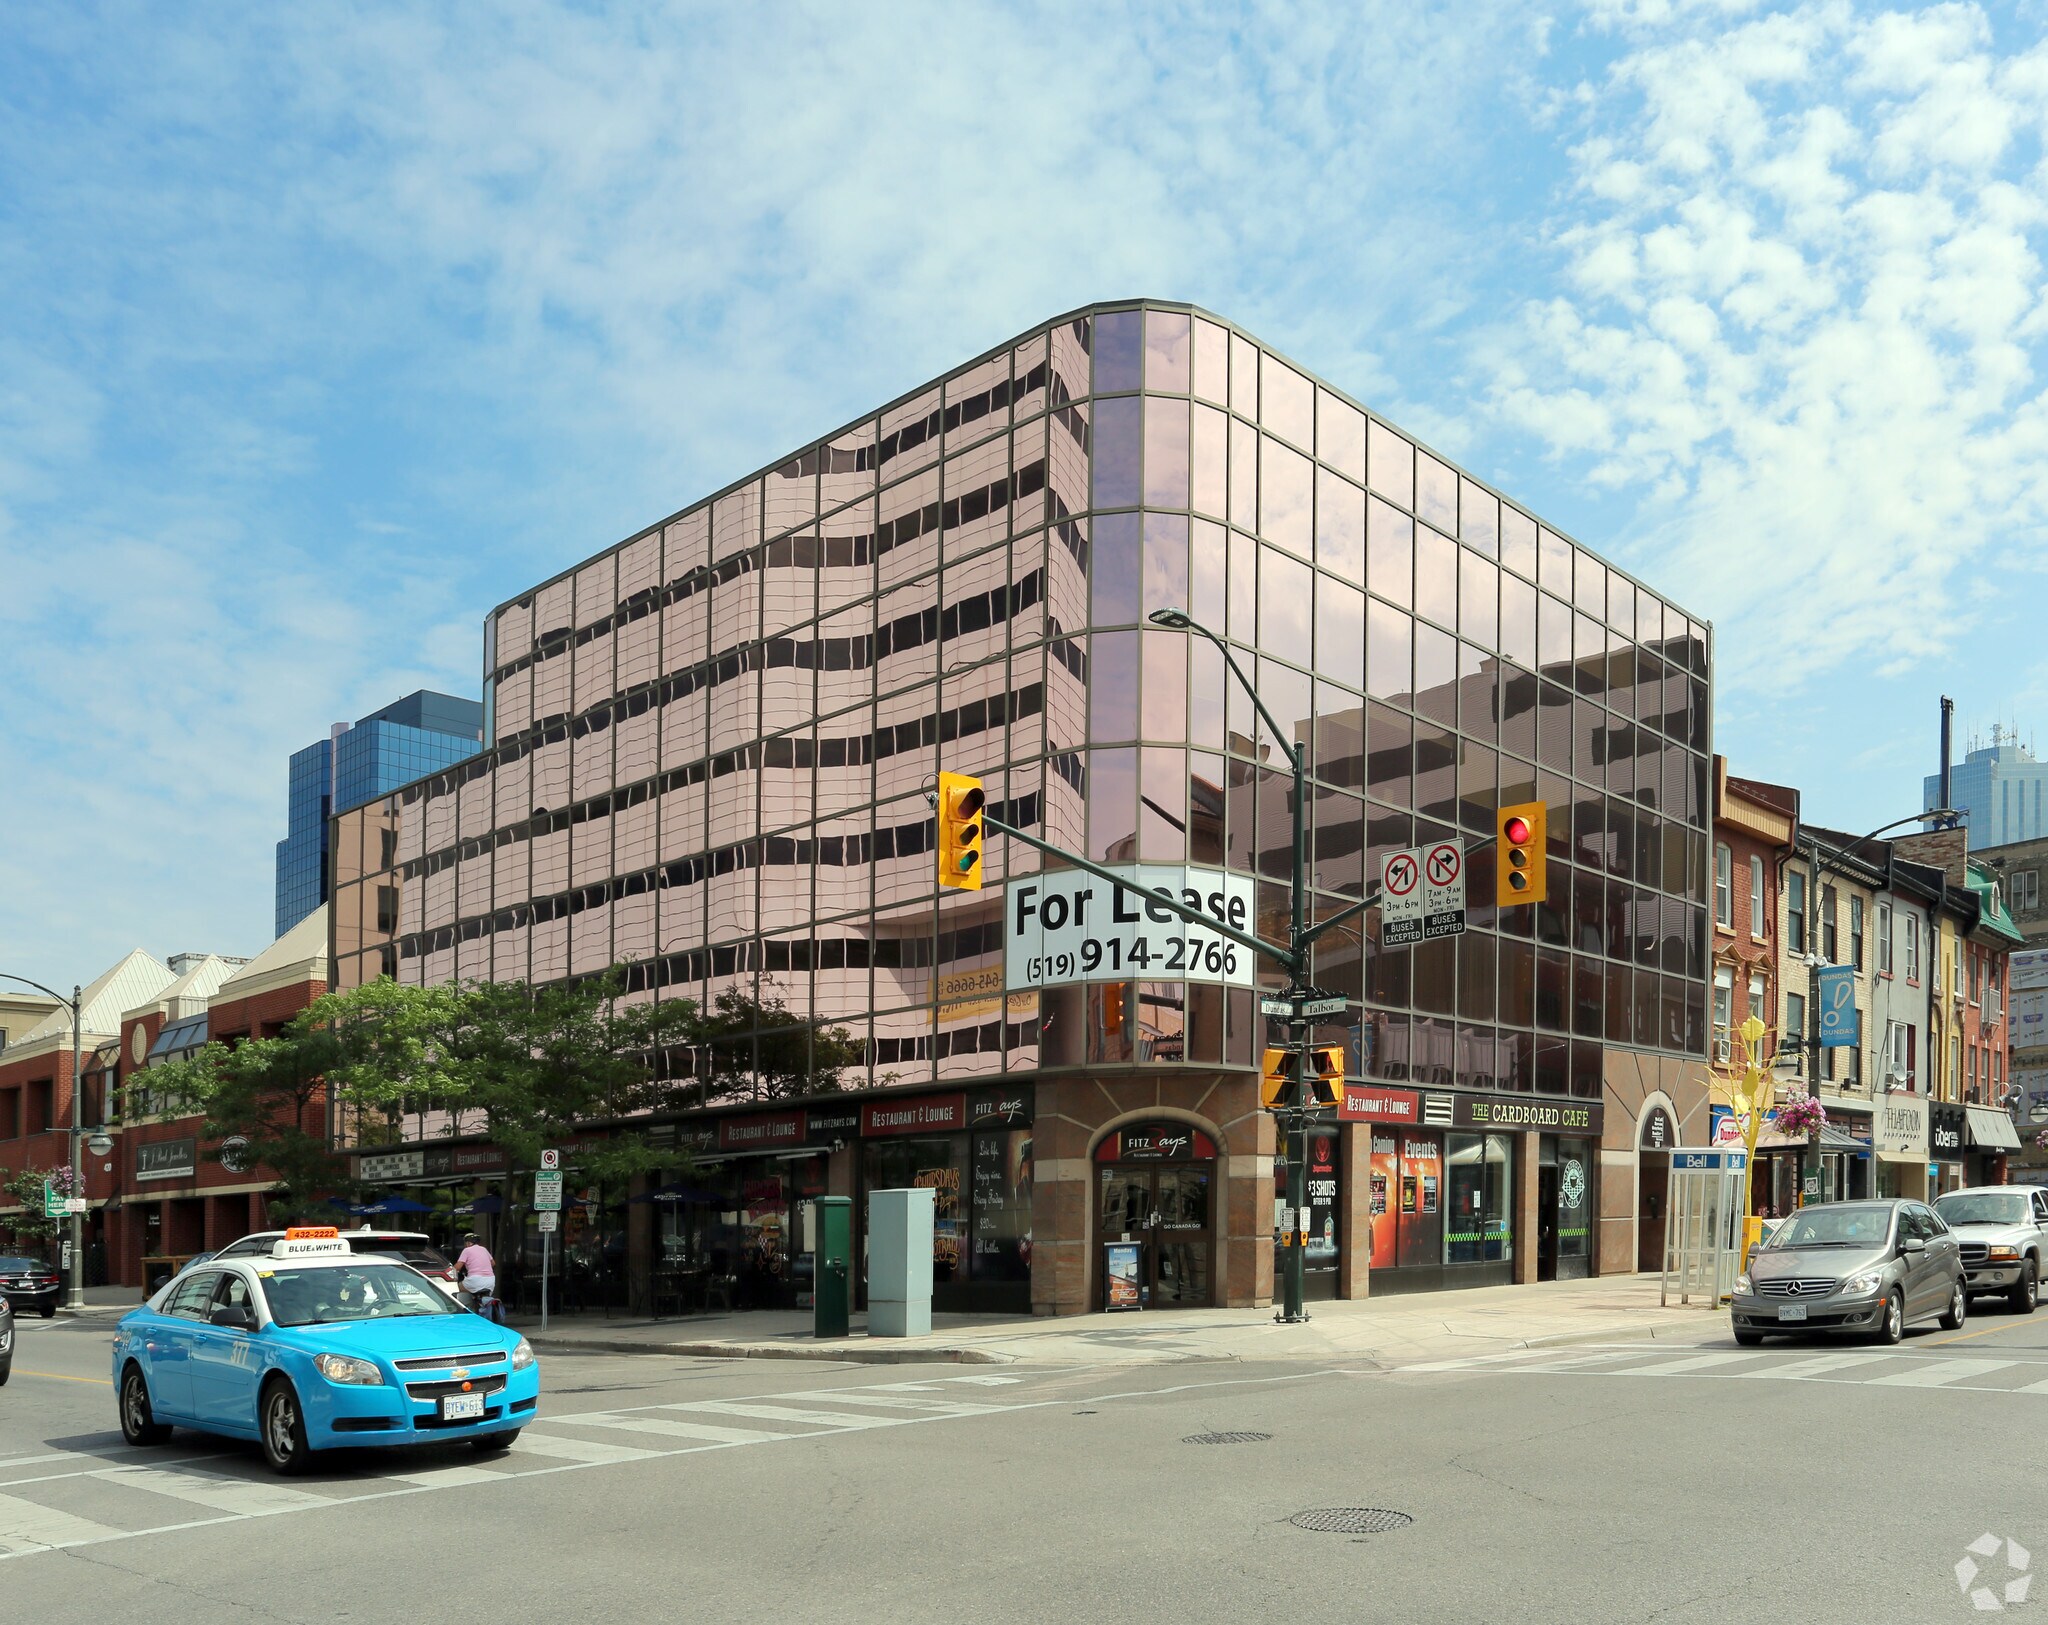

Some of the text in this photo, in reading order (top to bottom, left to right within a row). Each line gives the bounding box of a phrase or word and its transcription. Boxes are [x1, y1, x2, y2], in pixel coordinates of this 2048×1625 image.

[1017, 883, 1245, 935] For Lease
[1432, 914, 1456, 925] BUSES
[1391, 923, 1414, 933] BUSES
[1426, 923, 1463, 936] EXCEPTED
[1385, 931, 1420, 943] EXCEPTED
[1027, 937, 1236, 982] (519) 914-2766
[1821, 973, 1852, 981] DUNDAS
[1308, 1003, 1334, 1014] Talbot
[975, 1103, 992, 1115] FITZ
[1472, 1103, 1589, 1127] THE CARDBOARD CAFÉ
[1128, 1138, 1150, 1148] FITZ
[1373, 1135, 1437, 1159] Coming Events
[1686, 1155, 1707, 1168] Bell
[1308, 1181, 1336, 1196] $3 SHOTS
[294, 1230, 335, 1239] 432-2222
[230, 1341, 250, 1366] 377
